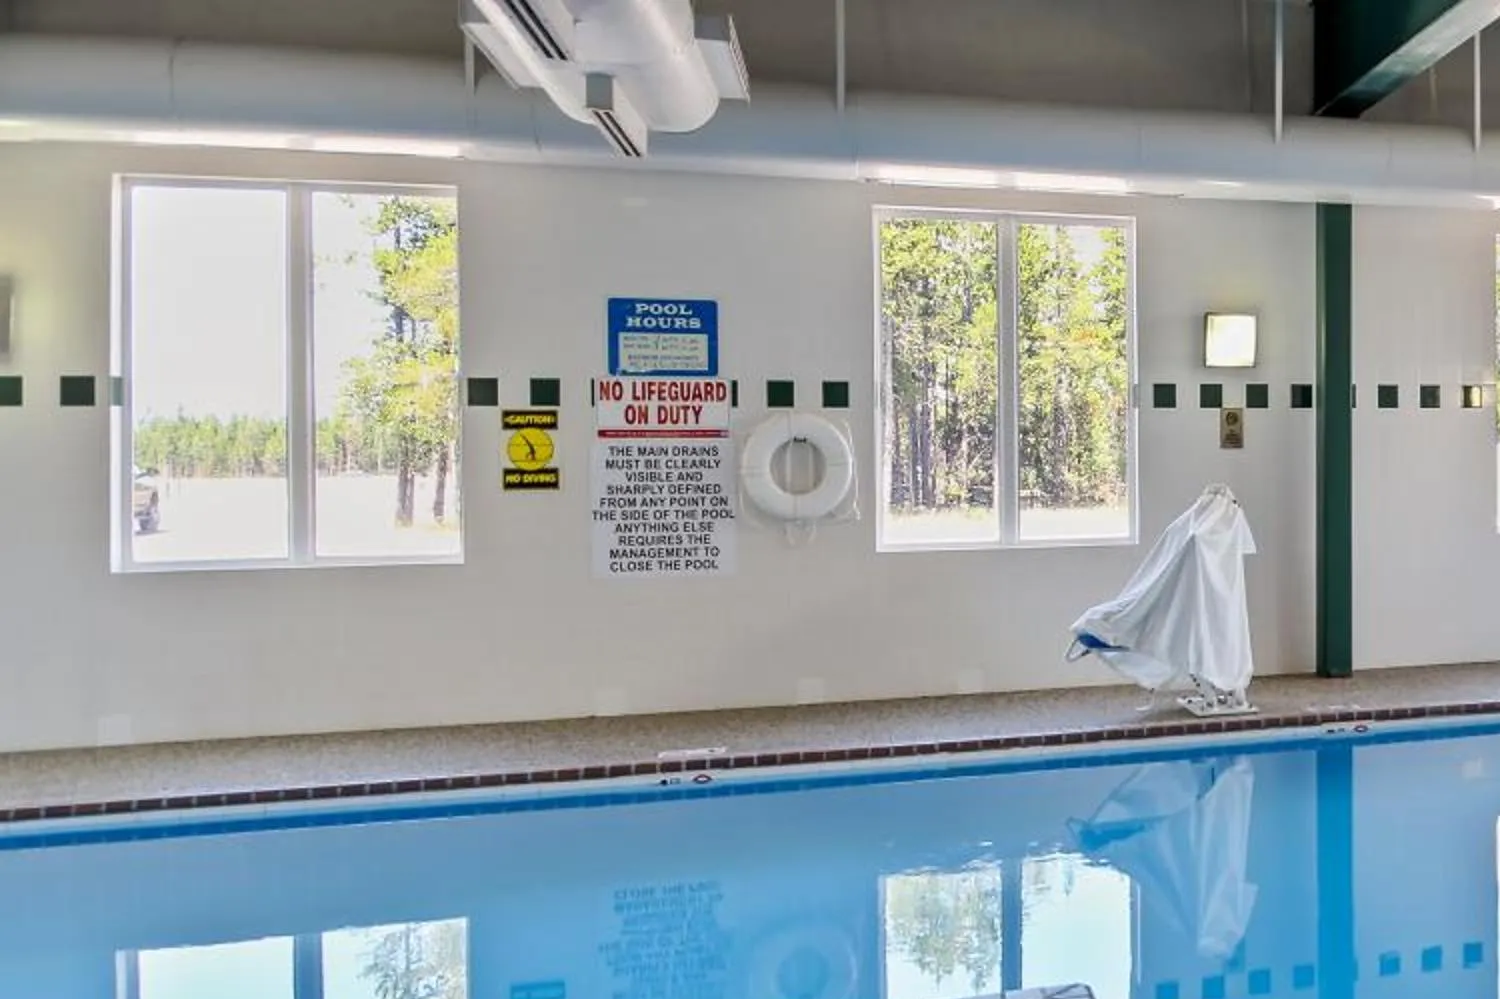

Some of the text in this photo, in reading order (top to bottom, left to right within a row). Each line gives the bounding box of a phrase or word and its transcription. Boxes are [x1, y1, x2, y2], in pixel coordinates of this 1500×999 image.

[634, 303, 693, 315] POOL
[625, 316, 702, 329] HOURS
[599, 381, 727, 401] NO LIFEGUARD
[508, 415, 555, 424] CAUTION
[624, 404, 703, 425] ON DUTY
[608, 445, 720, 457] THE MAIN DRAINS
[605, 458, 721, 470] MUST BE CLEARLY
[505, 473, 521, 484] NO
[625, 471, 704, 482] VISIBLE AND
[607, 483, 722, 495] SHARPLY DEFINED
[599, 496, 729, 508] FROM ANY POINT ON
[592, 508, 735, 521] THE SIDE OF THE POOL
[615, 521, 716, 533] ANYTHING ELSE
[618, 533, 711, 546] REQUIRES THE
[609, 546, 721, 559] MANAGEMENT TO
[609, 559, 719, 573] CLOSE THE POOL
